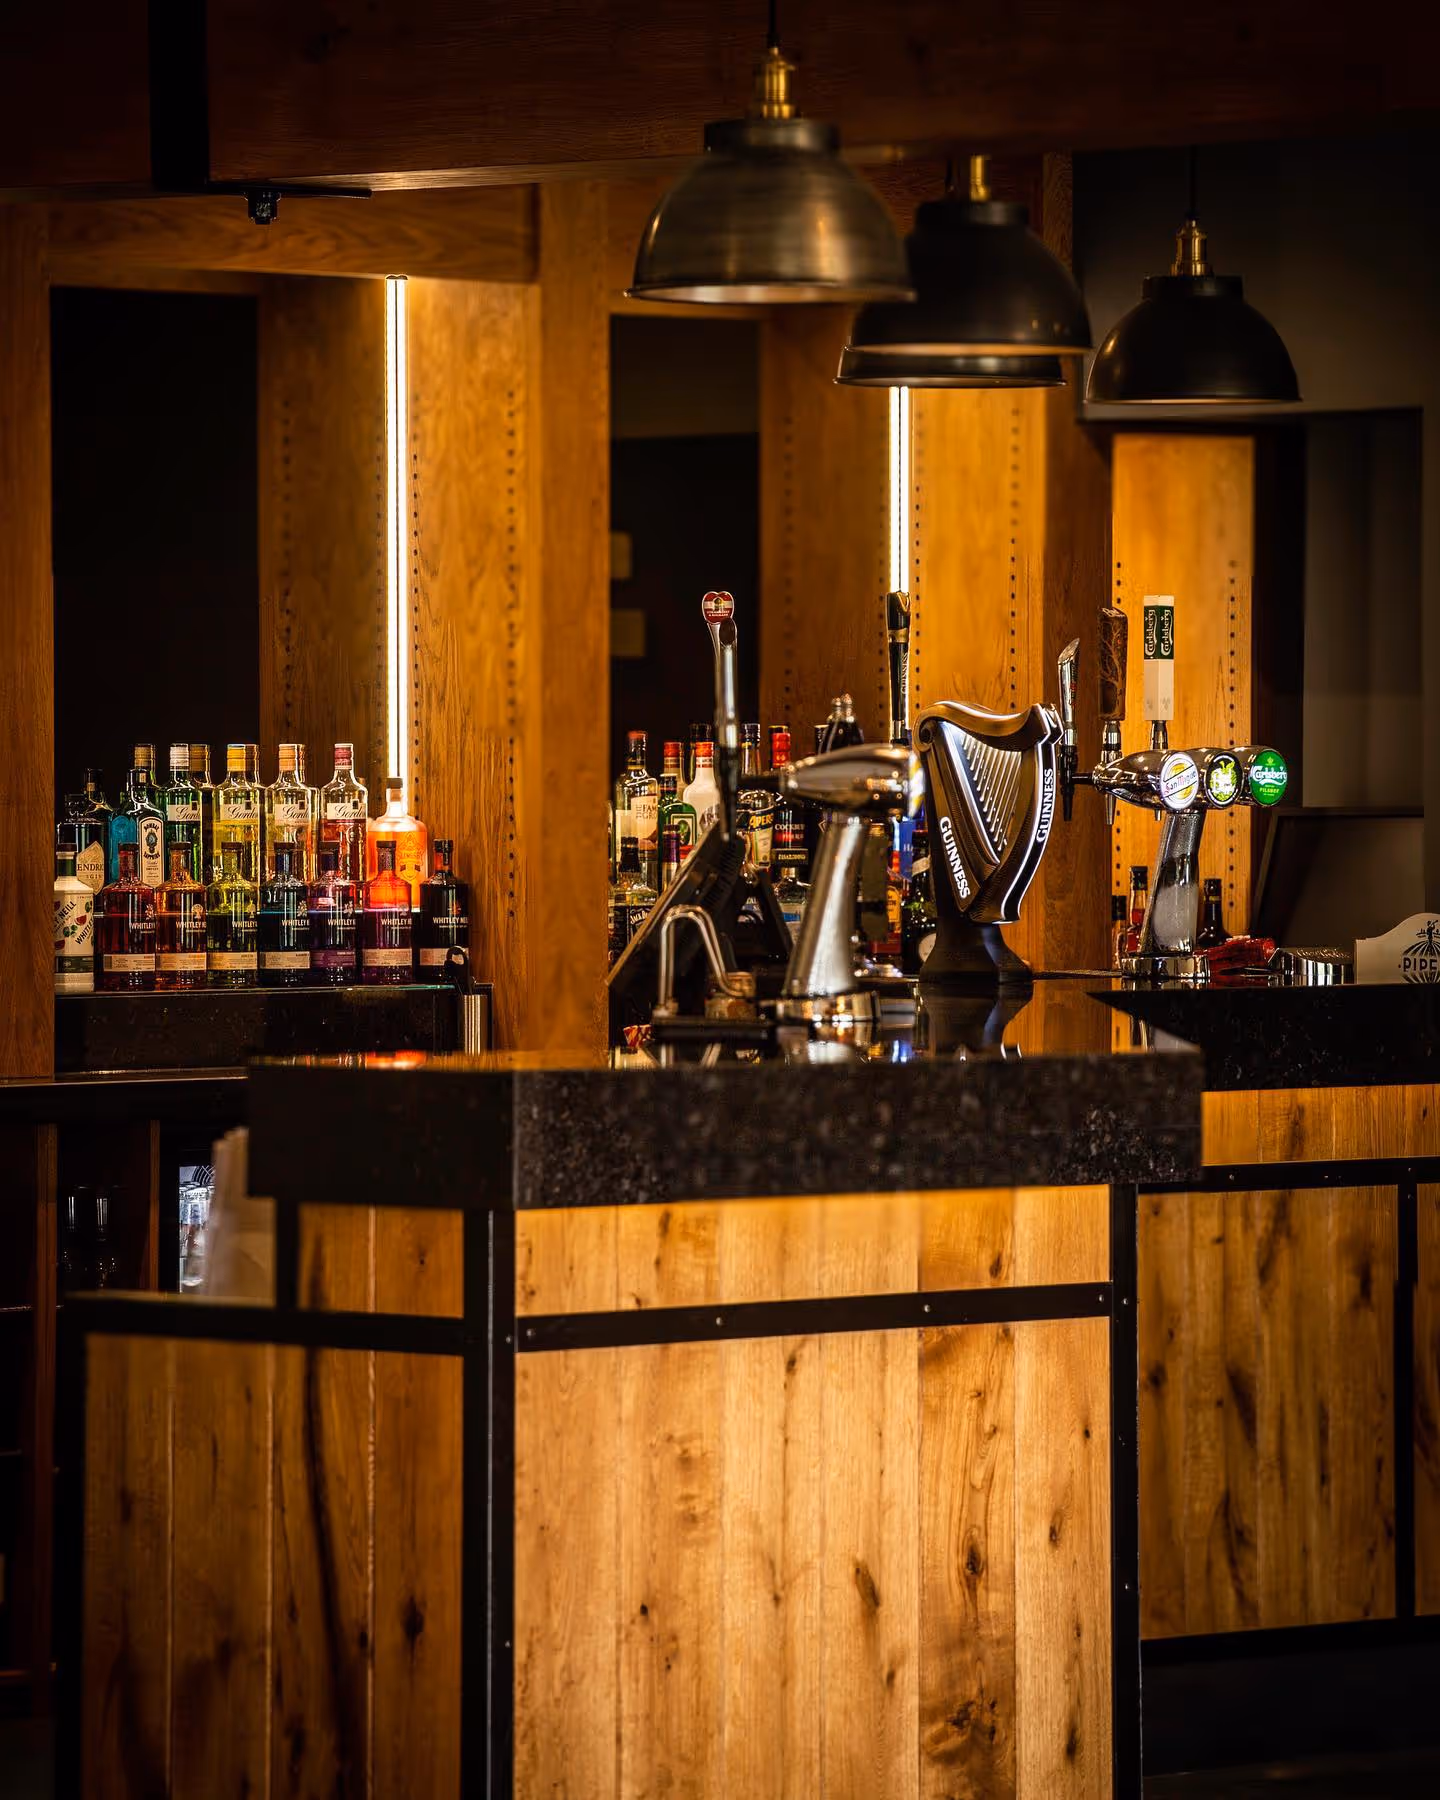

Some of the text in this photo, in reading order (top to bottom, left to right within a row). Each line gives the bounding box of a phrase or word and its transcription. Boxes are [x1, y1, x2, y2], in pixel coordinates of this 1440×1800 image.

[1144, 609, 1157, 656] Carlsberg
[1160, 609, 1173, 656] Carlsberg
[1250, 765, 1288, 785] Carlsberg
[1035, 768, 1053, 843] GUINNESS
[939, 816, 971, 899] GUINNESS
[327, 918, 353, 926] WHITLEY
[381, 918, 407, 926] WHITLEY
[433, 916, 460, 924] WHITLEY
